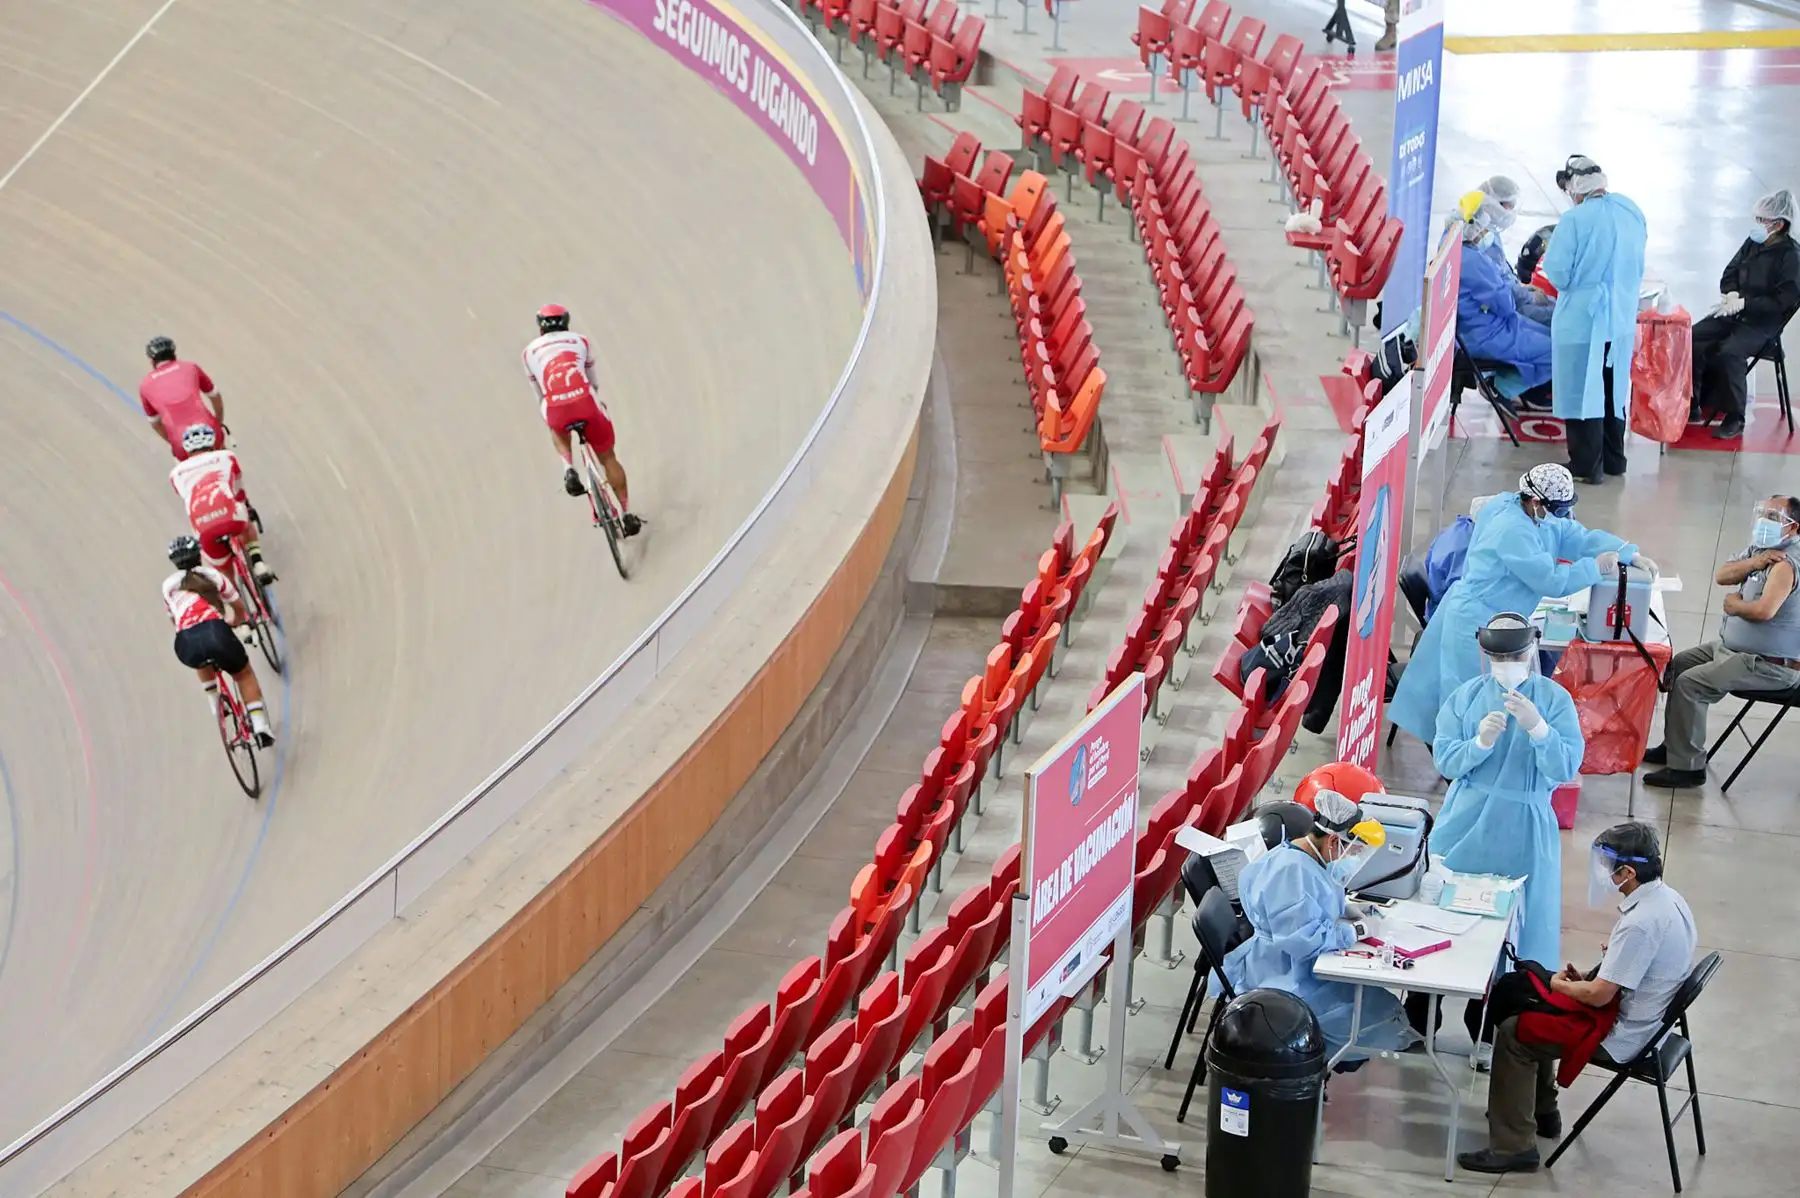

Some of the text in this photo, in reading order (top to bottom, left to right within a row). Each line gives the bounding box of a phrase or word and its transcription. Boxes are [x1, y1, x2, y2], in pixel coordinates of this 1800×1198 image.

[653, 0, 818, 166] SEGUIMOS JUGANDO
[1398, 59, 1433, 103] MINSA
[551, 387, 584, 402] PERU
[1033, 868, 1059, 928] ÁREA
[1060, 852, 1073, 901] DE
[1073, 792, 1135, 885] VACUNACIÓN
